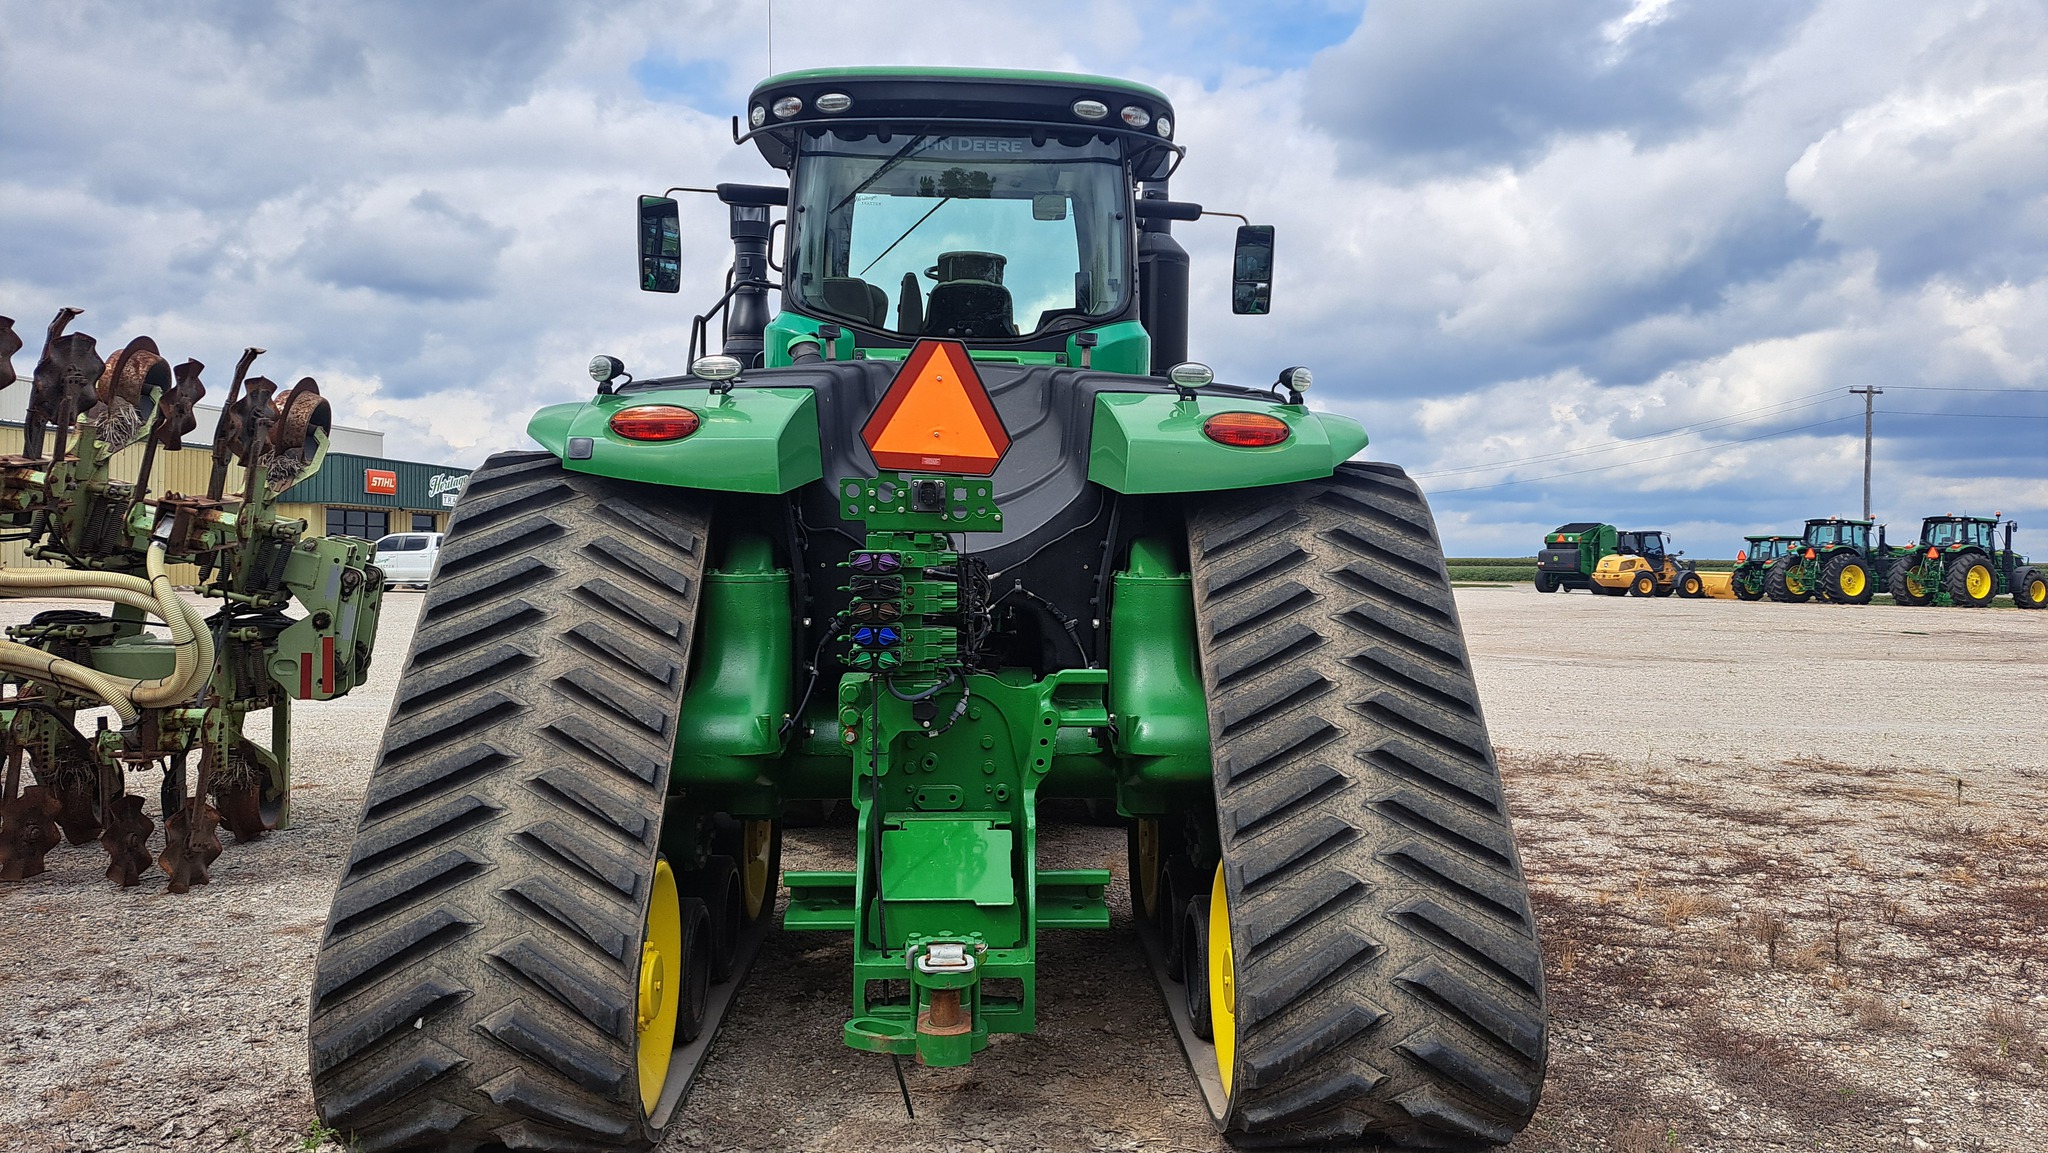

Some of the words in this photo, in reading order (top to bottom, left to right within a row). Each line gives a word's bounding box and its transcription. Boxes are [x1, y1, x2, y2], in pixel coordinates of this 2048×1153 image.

[901, 136, 953, 151] OHN
[958, 137, 1023, 152] DEERE
[371, 477, 395, 488] STIHL
